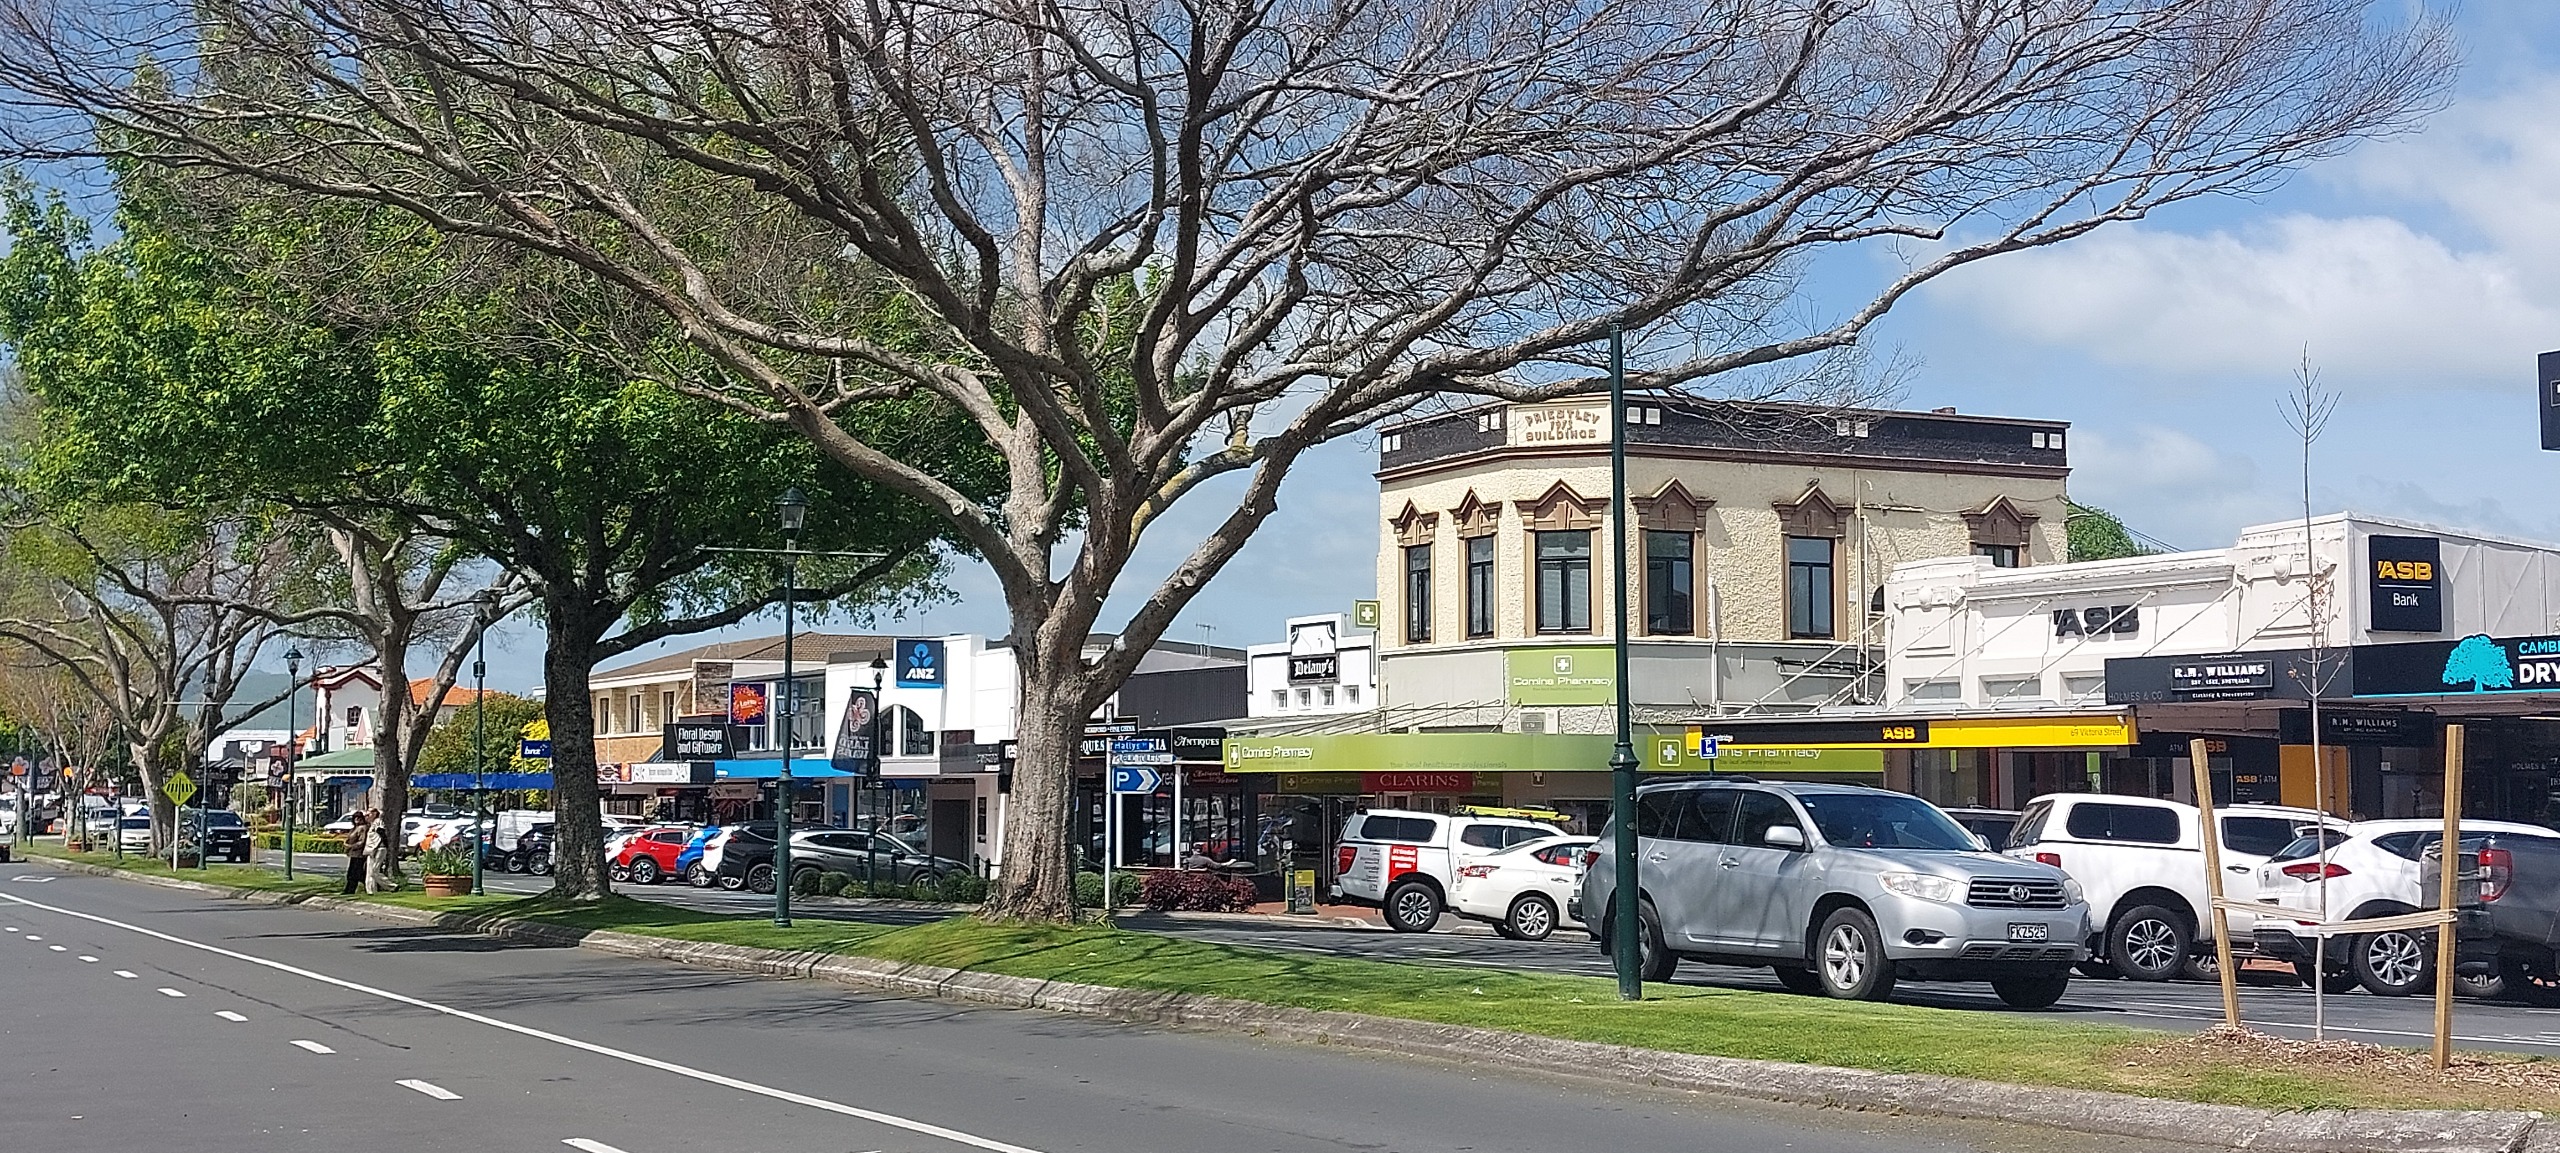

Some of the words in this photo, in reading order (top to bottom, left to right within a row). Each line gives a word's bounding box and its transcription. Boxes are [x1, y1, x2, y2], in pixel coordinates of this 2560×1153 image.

[2393, 592, 2419, 607] Bank
[2518, 641, 2560, 654] CAMB
[905, 667, 935, 680] ANZ
[1294, 658, 1335, 677] Delany's
[2206, 664, 2267, 677] WILLIAMS
[1513, 677, 1554, 686] Comins
[1557, 676, 1614, 687] Pharmacy
[2108, 691, 2141, 700] HOLMES
[2152, 691, 2163, 700] CO
[2356, 717, 2398, 728] WILLIAMS
[678, 727, 698, 741] Floral
[699, 728, 723, 742] Design
[1882, 726, 1916, 740] ASB
[524, 745, 541, 755] bnz
[677, 742, 691, 754] and
[692, 742, 722, 755] Giftware
[1273, 745, 1314, 760] Pharmacy
[2169, 743, 2184, 751] ATM
[2206, 740, 2227, 752] SB
[1405, 760, 1422, 768] local
[1116, 771, 1130, 788] P
[1379, 773, 1460, 787] CLARINS
[2264, 775, 2277, 784] ATM
[2010, 926, 2046, 938] FKZ525
